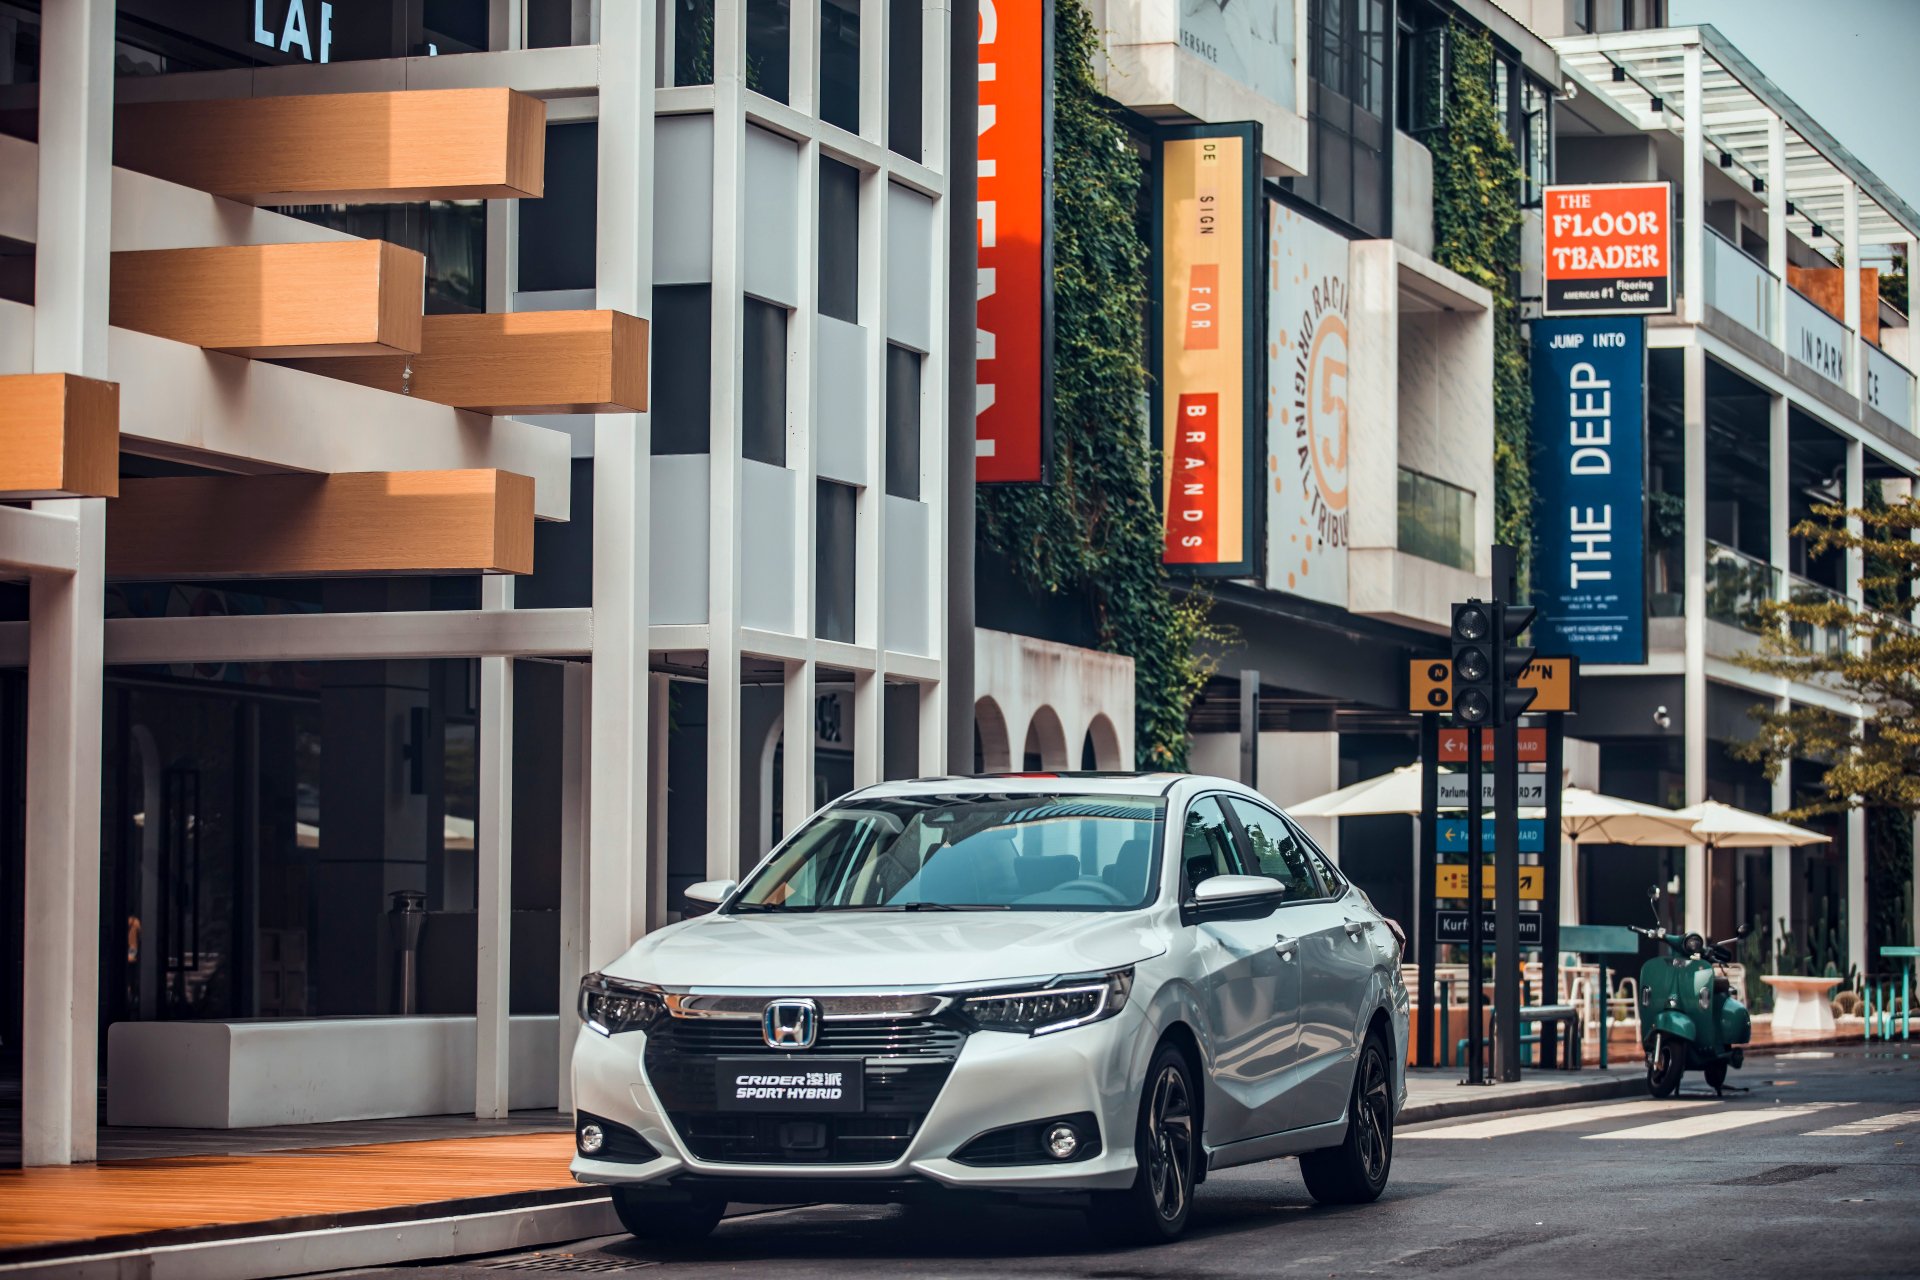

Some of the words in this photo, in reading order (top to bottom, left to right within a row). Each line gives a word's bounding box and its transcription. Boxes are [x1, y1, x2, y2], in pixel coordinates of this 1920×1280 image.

[1203, 144, 1216, 160] DE
[1557, 194, 1591, 209] THE
[1200, 195, 1214, 235] SIGN
[1552, 211, 1659, 237] FLOOR
[1601, 287, 1614, 299] #1
[1616, 279, 1654, 292] Flooring
[1620, 292, 1649, 302] Outlet
[1190, 287, 1211, 328] FOR
[1550, 334, 1584, 349] JUMP
[1593, 332, 1626, 347] INTO
[1570, 361, 1611, 475] DEEP
[1181, 405, 1207, 547] BRANDS
[1570, 504, 1611, 590] THE
[735, 1075, 805, 1086] CRIDER
[735, 1087, 786, 1099] SPORT
[786, 1087, 843, 1099] HYBRID
